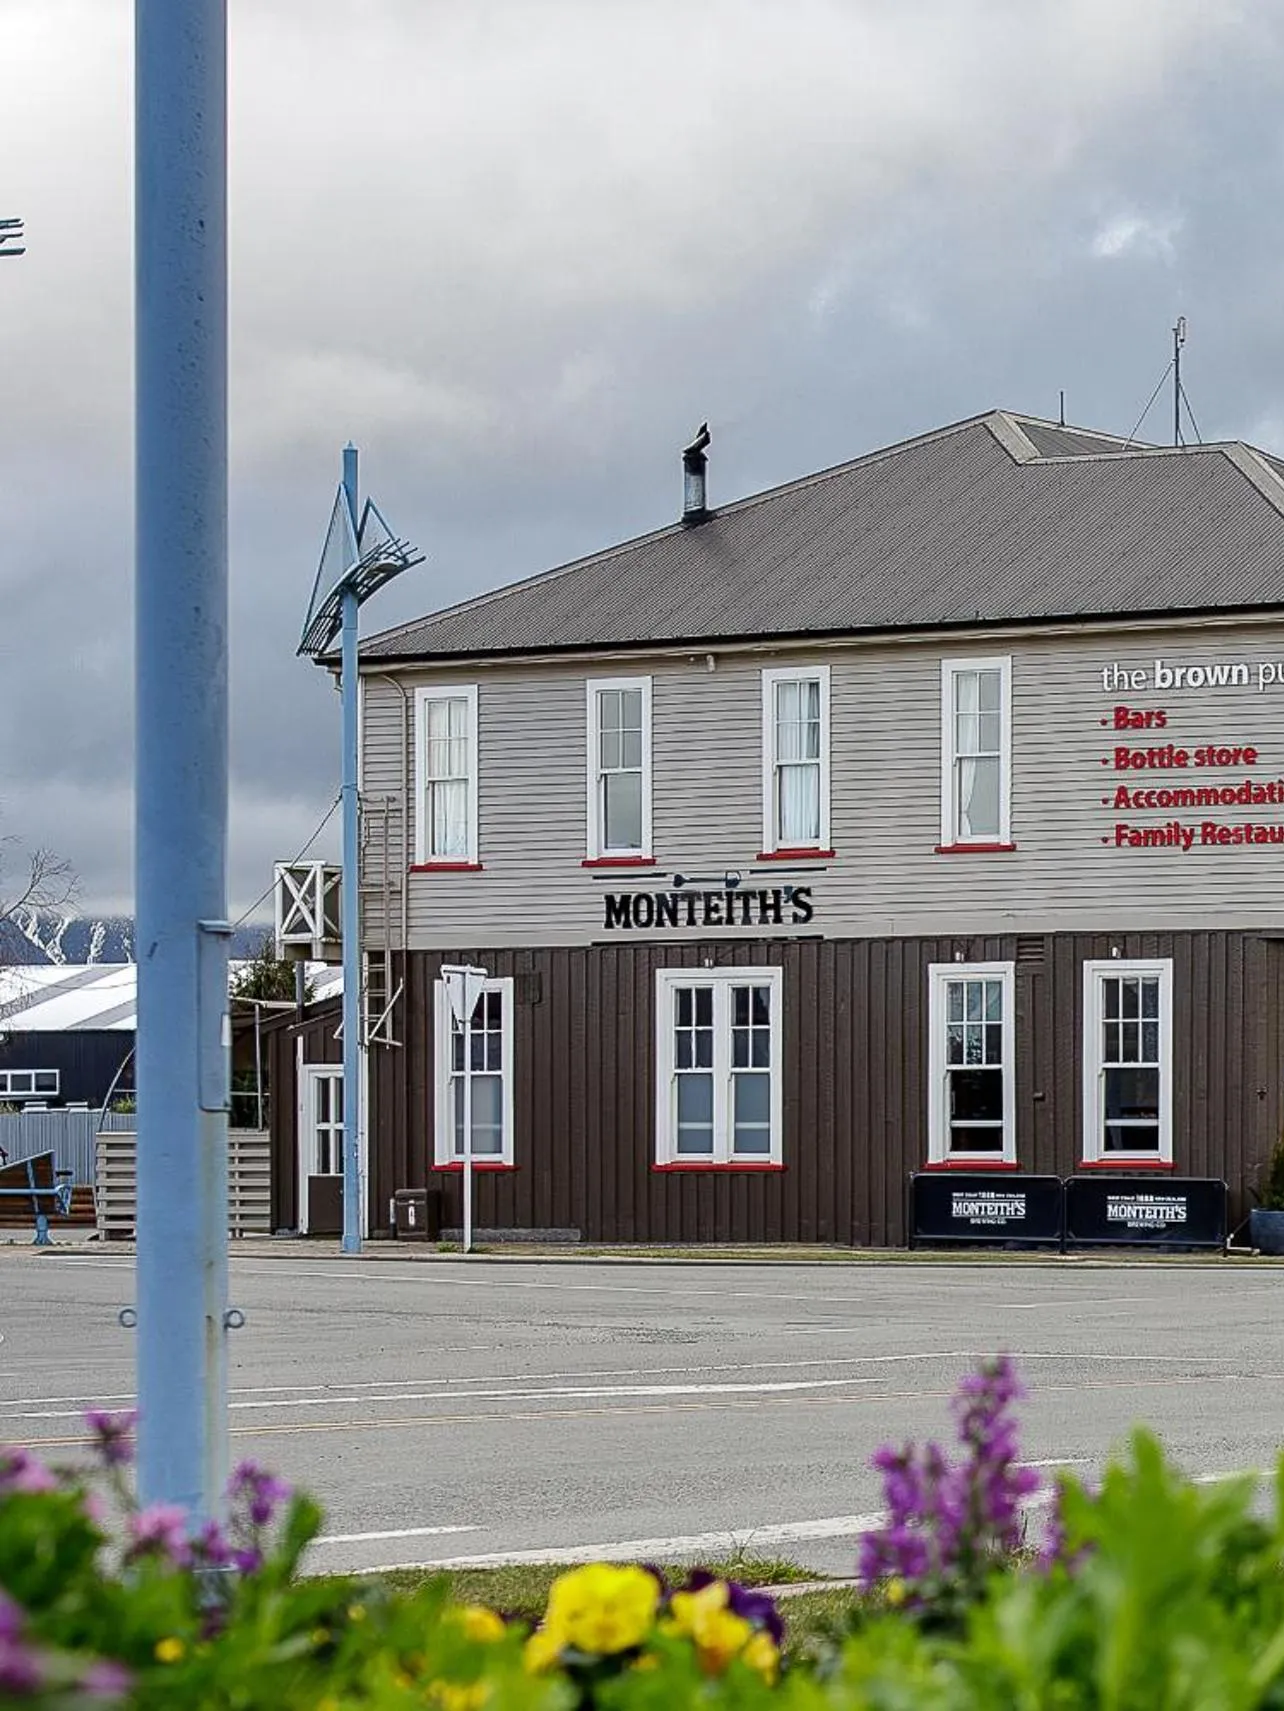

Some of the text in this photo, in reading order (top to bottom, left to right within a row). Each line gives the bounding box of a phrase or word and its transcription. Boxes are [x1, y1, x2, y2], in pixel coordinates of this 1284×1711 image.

[1101, 663, 1147, 692] the
[1154, 660, 1249, 689] brown
[1113, 706, 1167, 730] Bars
[1114, 744, 1258, 770] Bottle store
[1115, 821, 1195, 851] Family
[604, 886, 814, 929] MONTEITH'S
[952, 1201, 1026, 1216] MONTEITH'S
[1107, 1204, 1187, 1220] MONTEITH'S
